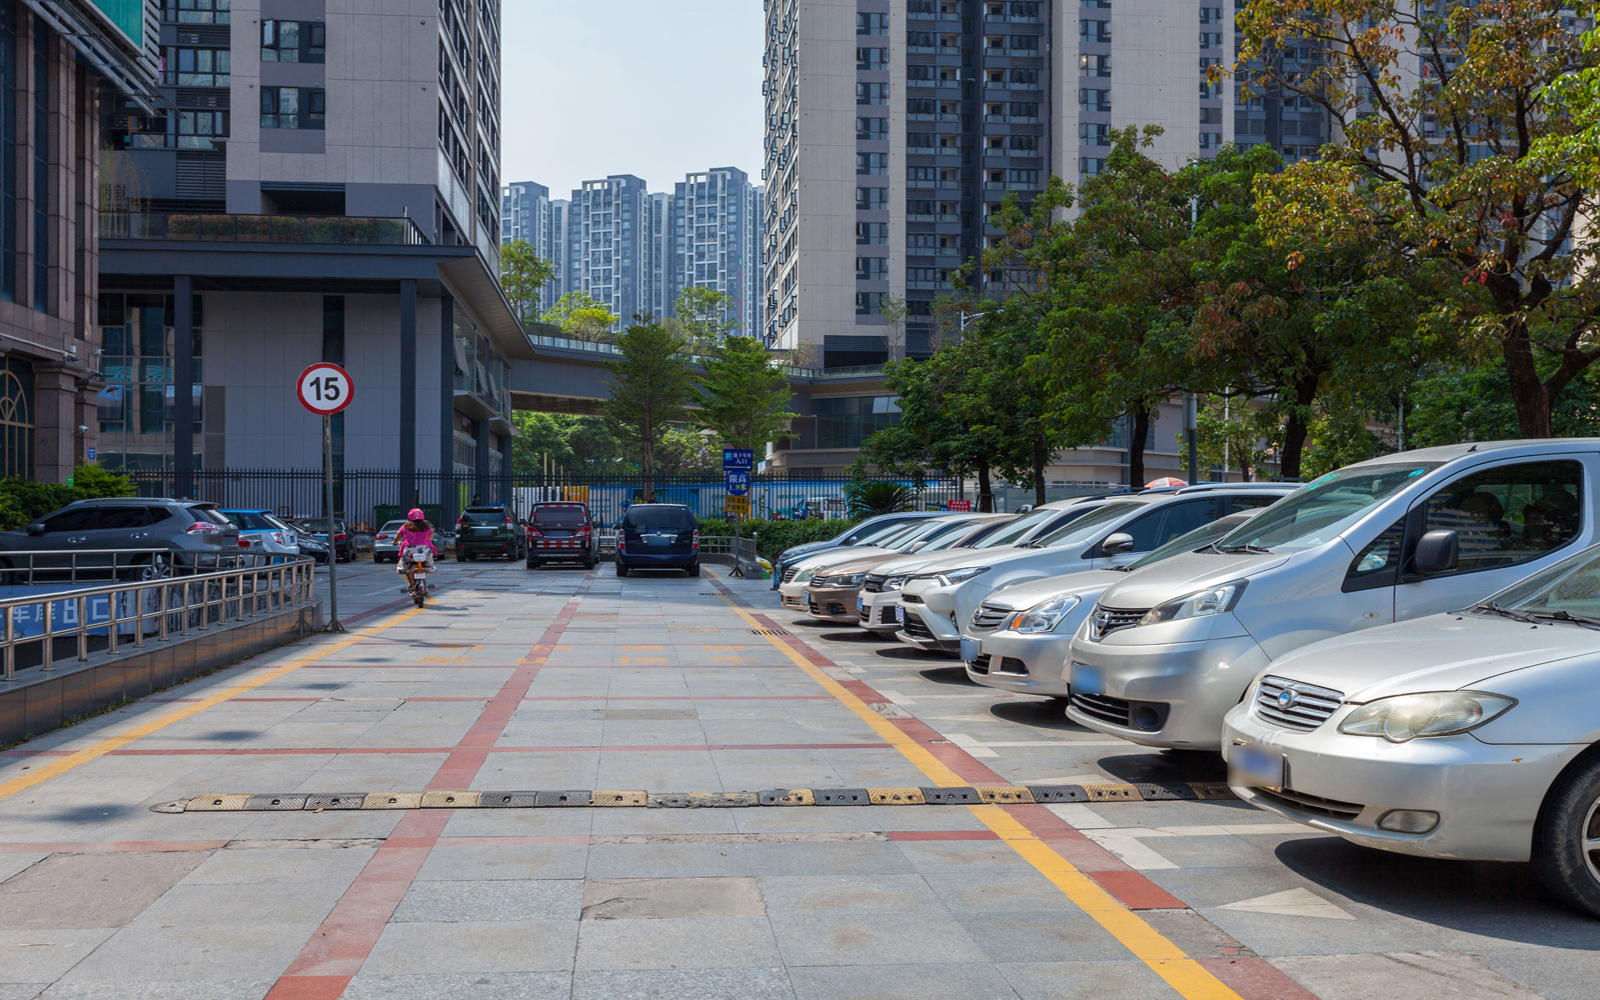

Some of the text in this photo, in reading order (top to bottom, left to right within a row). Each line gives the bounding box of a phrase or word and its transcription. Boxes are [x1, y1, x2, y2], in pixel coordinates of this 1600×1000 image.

[309, 376, 340, 401] 15
[729, 474, 747, 483] 限高
[729, 483, 747, 491] 1.9米
